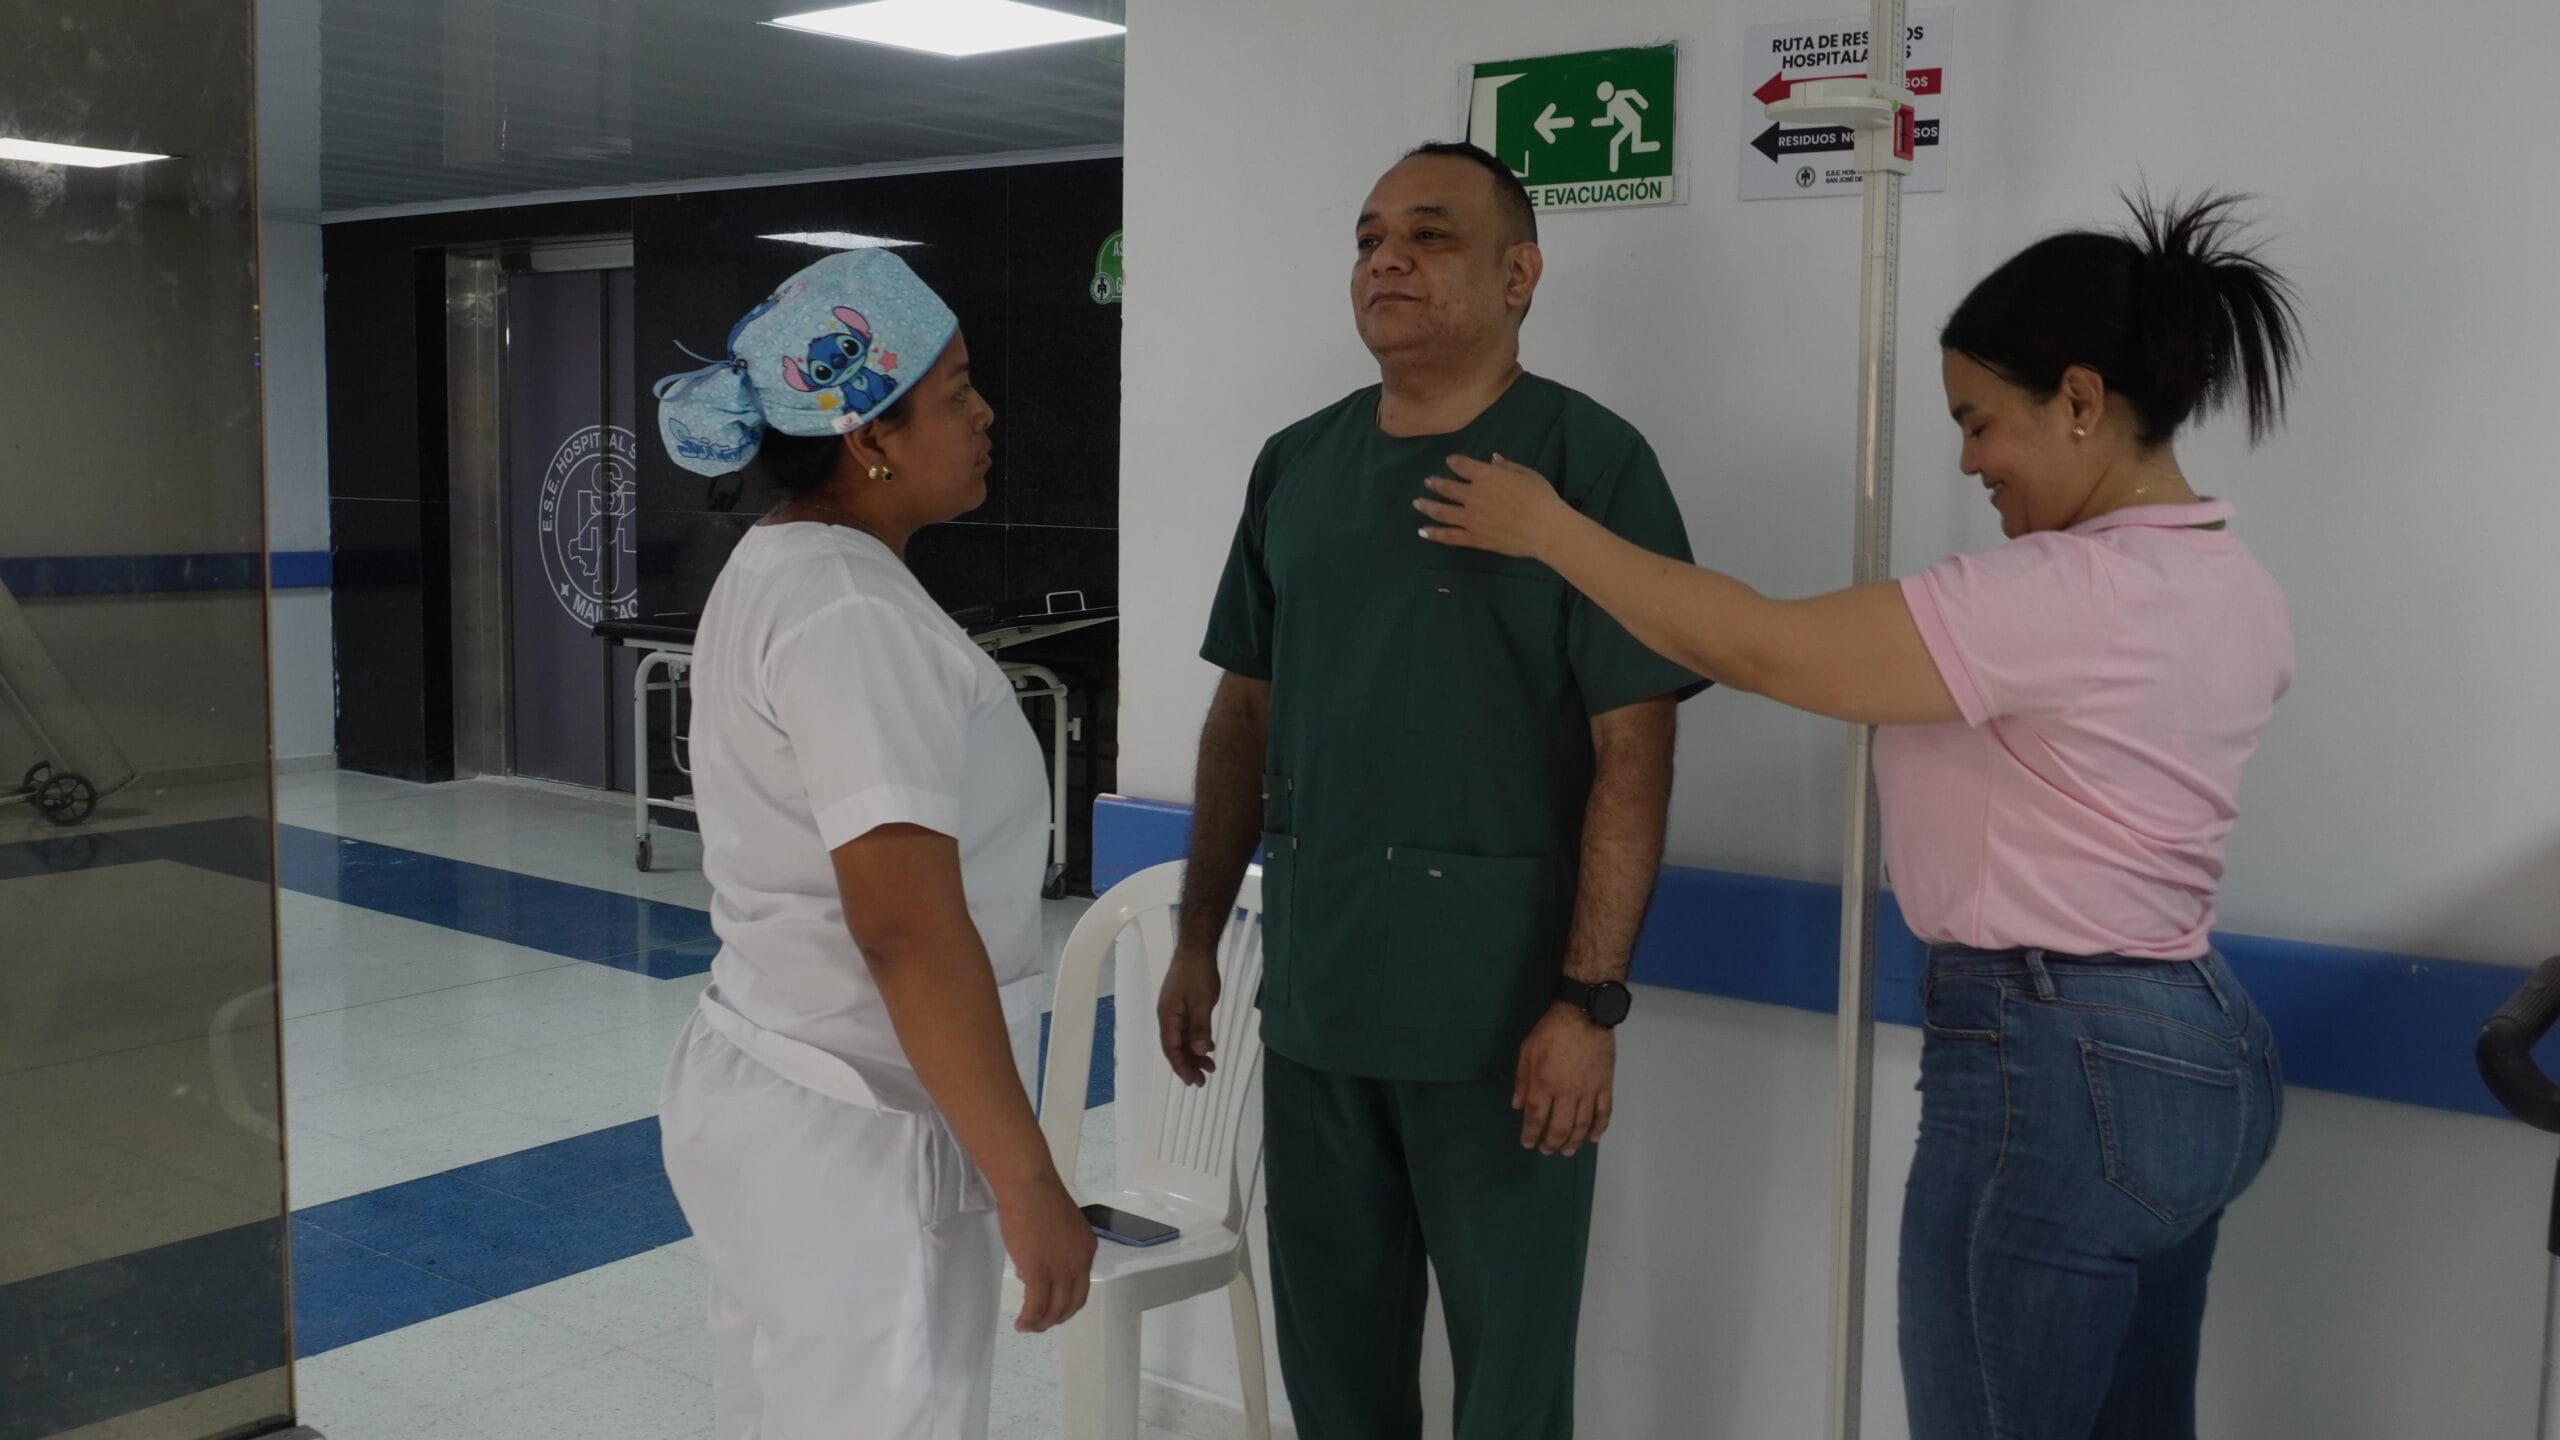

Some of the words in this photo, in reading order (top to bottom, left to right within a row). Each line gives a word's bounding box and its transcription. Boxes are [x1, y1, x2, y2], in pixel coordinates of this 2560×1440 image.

[1772, 36, 1815, 53] RUTA
[1818, 33, 1839, 49] DE
[1778, 133, 1836, 147] RESIDUOS
[1544, 177, 1662, 206] EVACUACIÓN
[542, 479, 560, 532] E.S.E.
[555, 432, 626, 475] HOSPITAL
